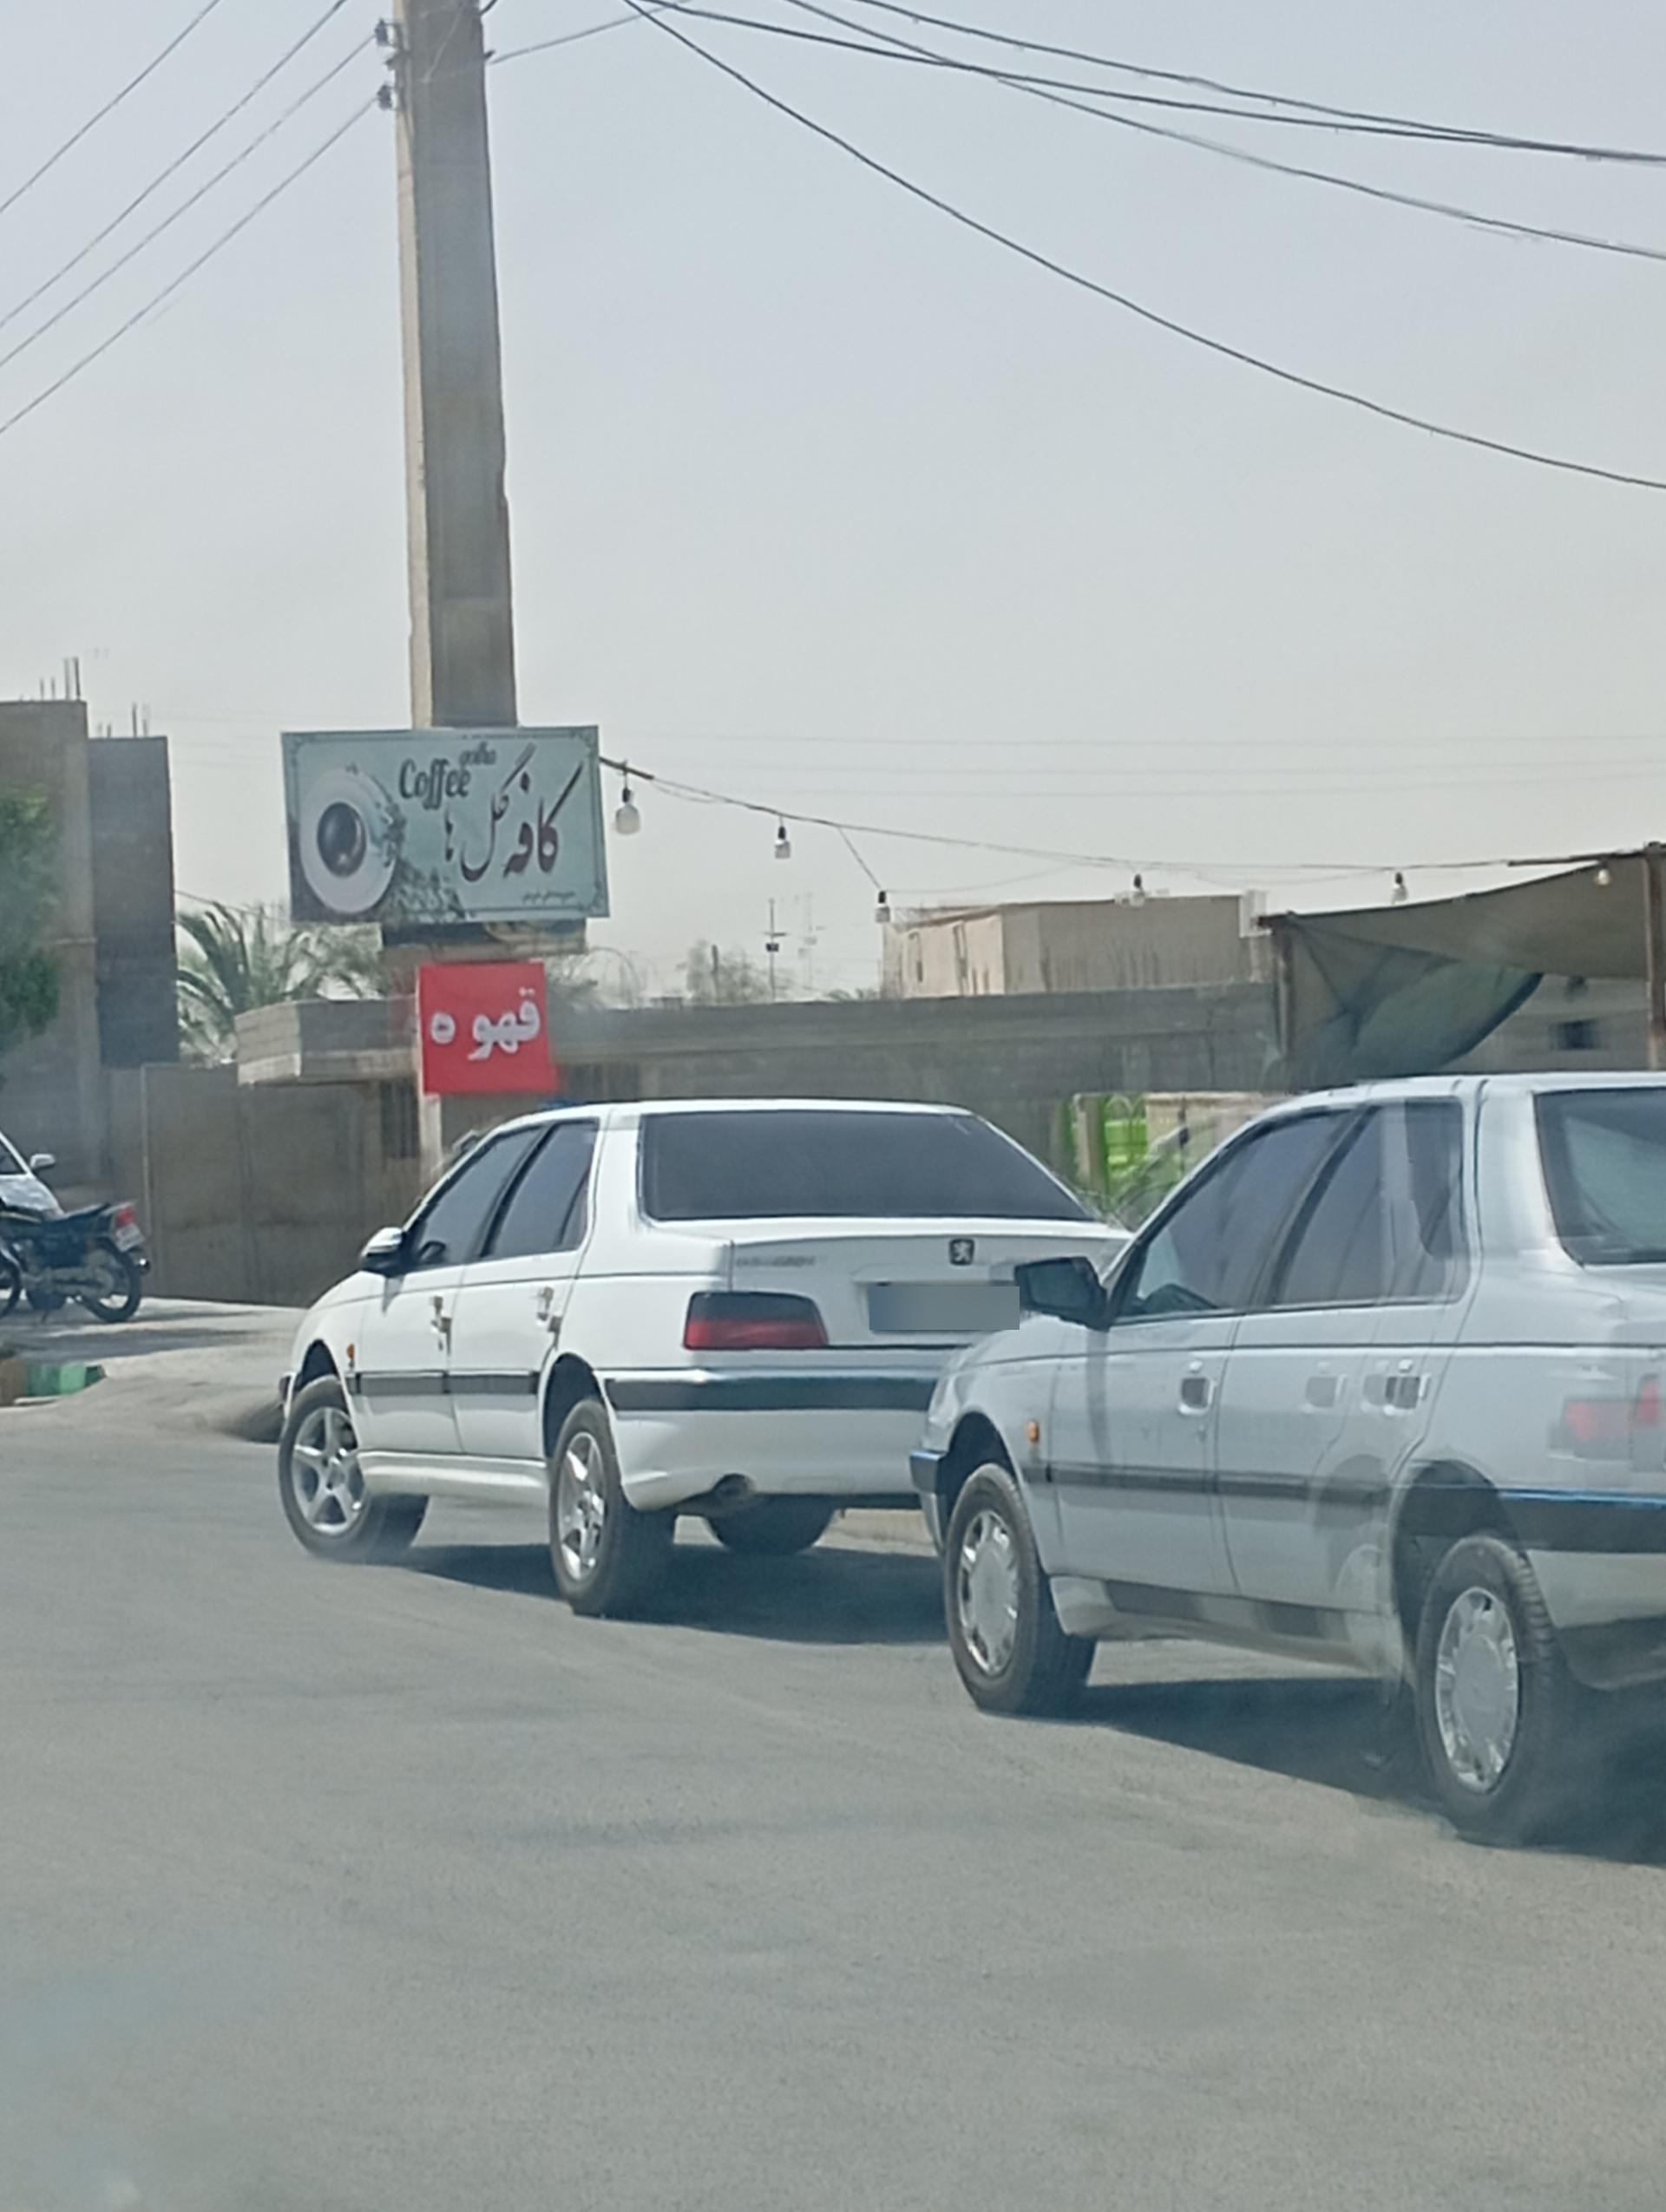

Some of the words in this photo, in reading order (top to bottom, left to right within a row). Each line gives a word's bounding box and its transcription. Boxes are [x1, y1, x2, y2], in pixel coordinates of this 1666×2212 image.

[399, 758, 471, 810] Coffee
[502, 761, 583, 878] کافه
[430, 986, 541, 1062] قهوه
